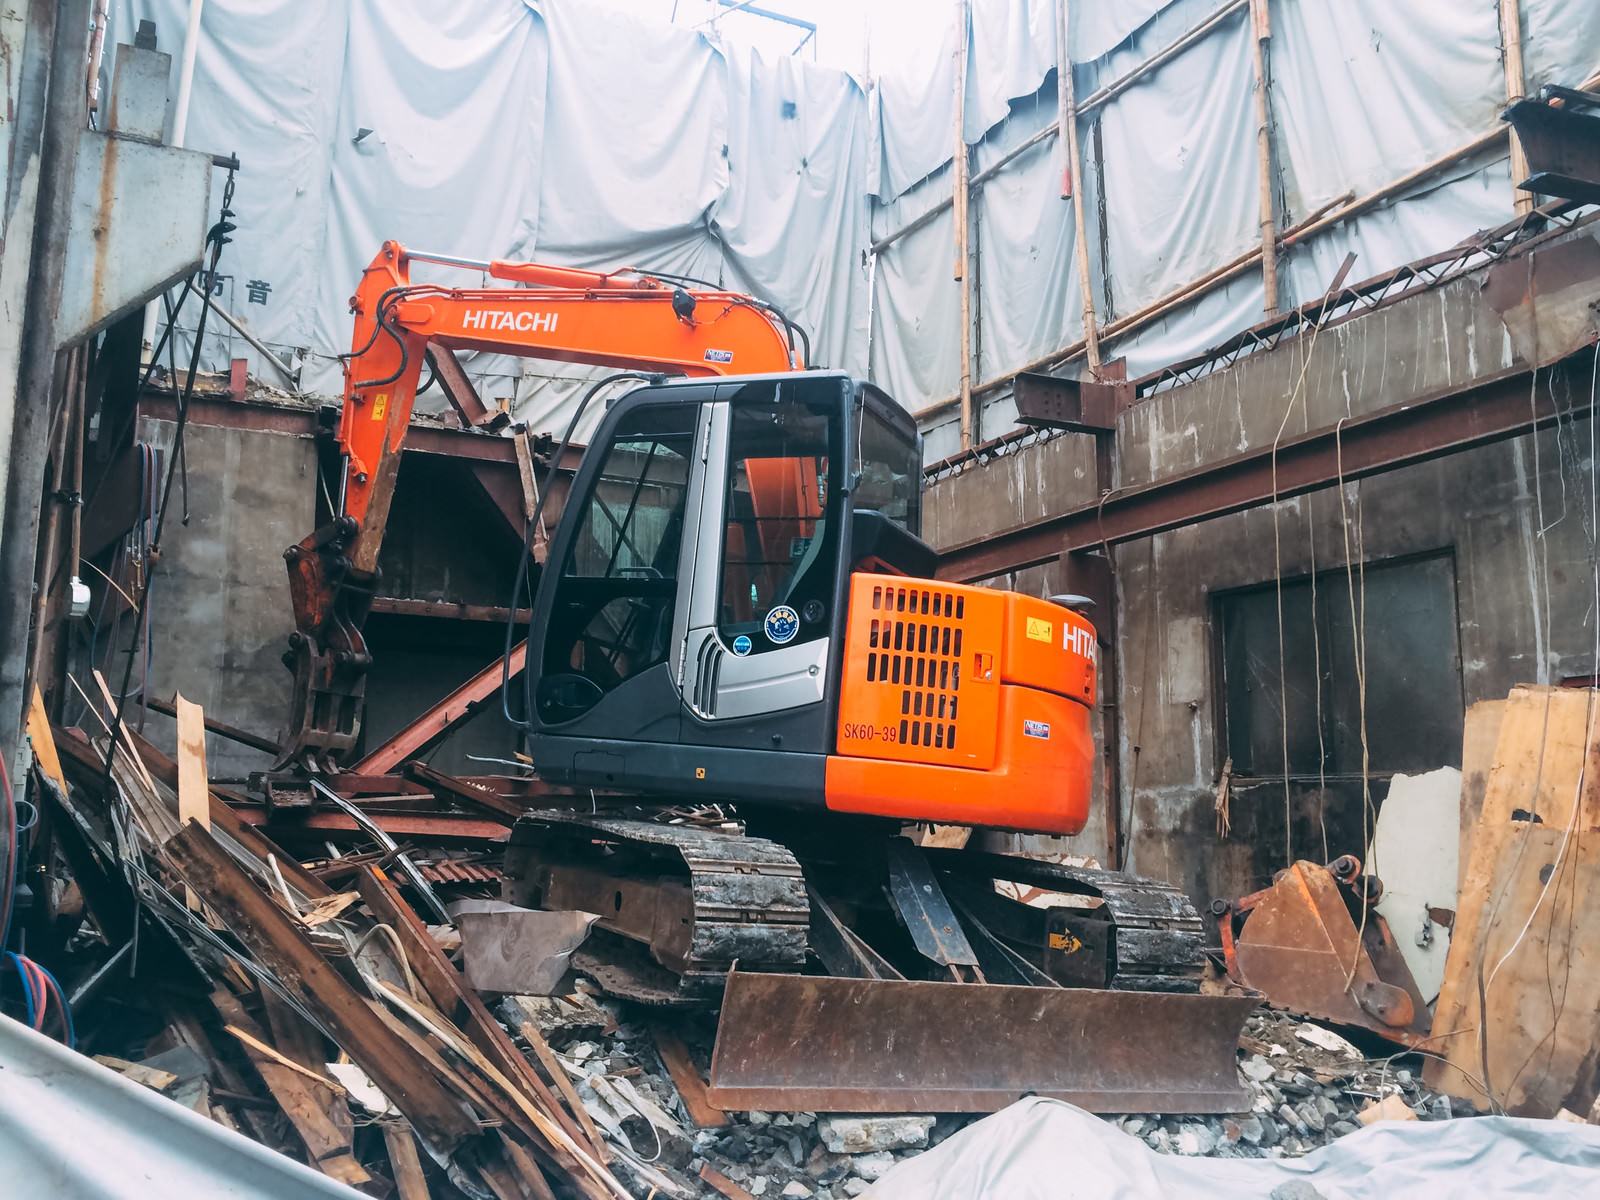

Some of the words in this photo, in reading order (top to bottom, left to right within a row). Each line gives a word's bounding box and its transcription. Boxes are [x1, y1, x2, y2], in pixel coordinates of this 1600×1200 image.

[462, 309, 559, 332] HITACHI
[1062, 621, 1098, 667] HITA
[844, 722, 897, 743] SK60-39
